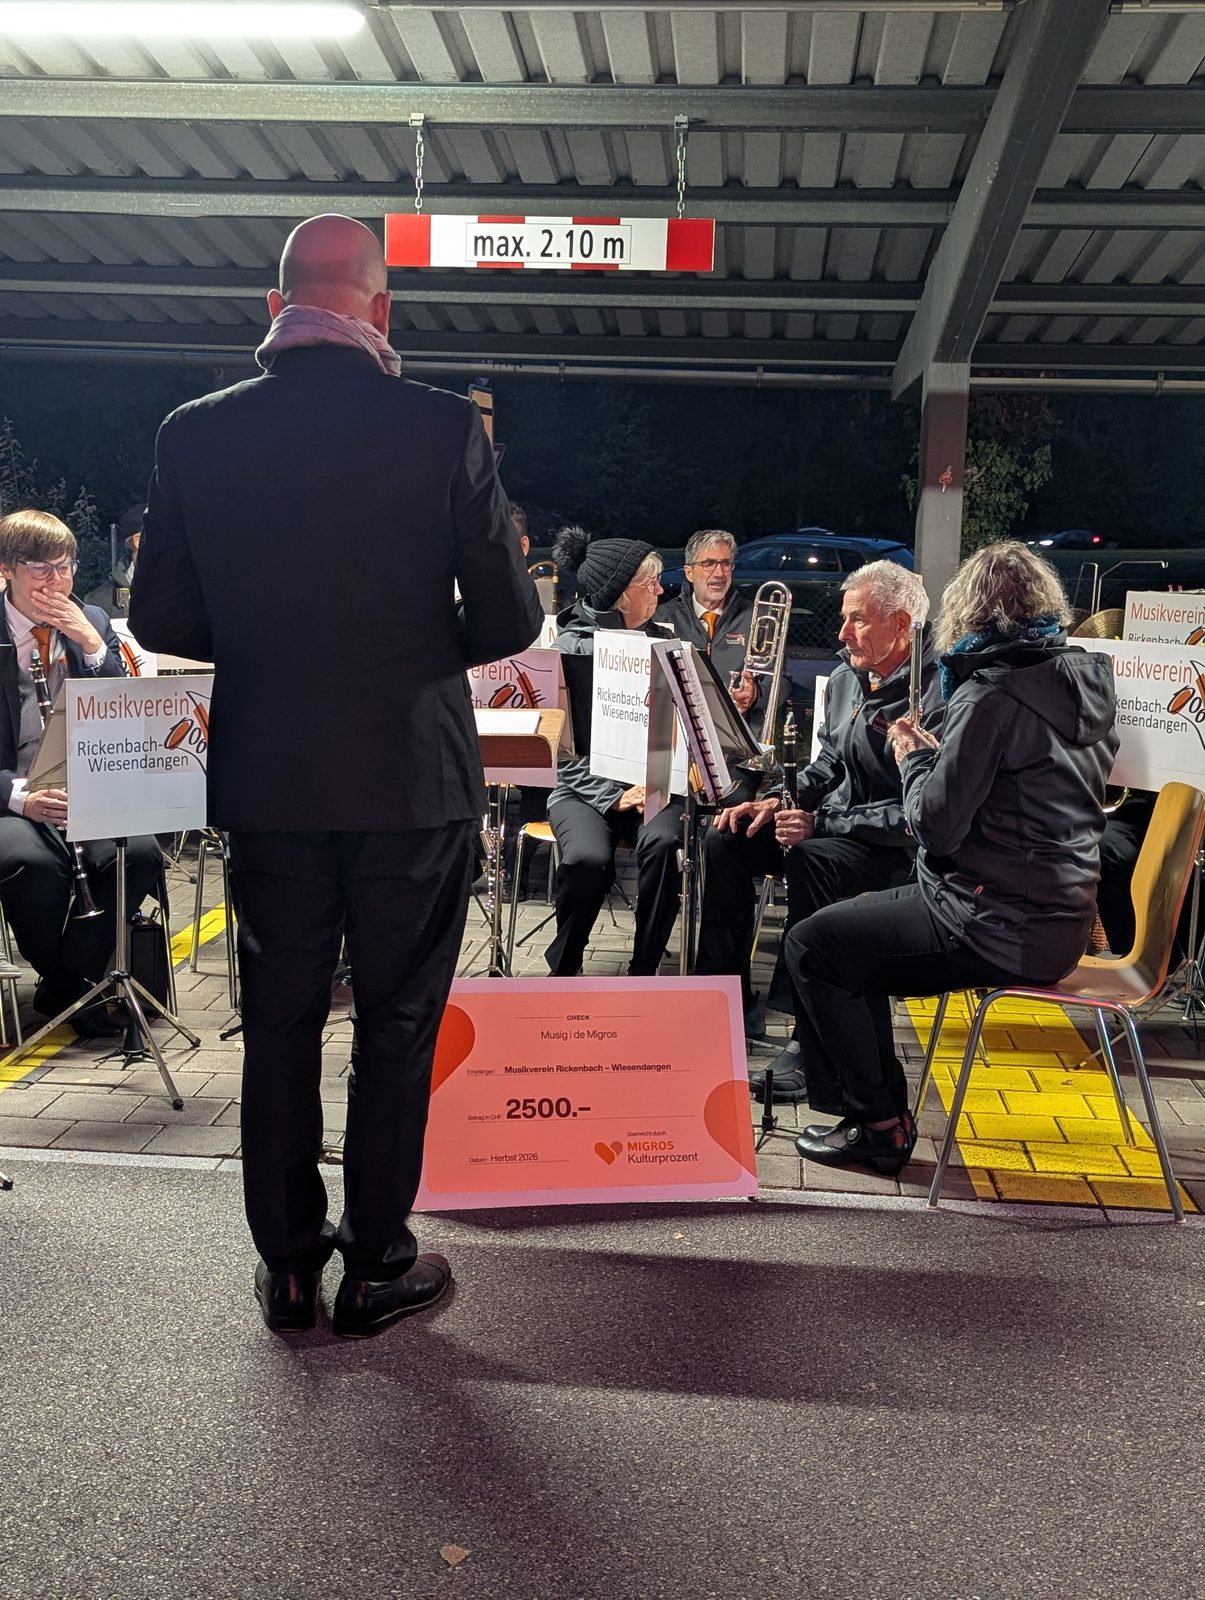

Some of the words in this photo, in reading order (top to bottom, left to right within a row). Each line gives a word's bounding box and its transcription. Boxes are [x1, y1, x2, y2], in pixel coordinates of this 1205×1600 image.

[473, 234, 531, 258] max.
[540, 229, 594, 259] 2.10
[603, 237, 624, 259] m
[1131, 602, 1205, 625] Musikverein
[598, 647, 650, 676] Musikvere
[76, 692, 190, 721] Musikverein
[597, 687, 645, 707] Rickenbach-
[1115, 694, 1167, 714] kenbach-
[602, 703, 649, 728] Wiesendang
[77, 736, 163, 757] Rickenbach-
[88, 754, 189, 773] Wiesendangen
[540, 1030, 568, 1042] Musig
[573, 1030, 586, 1040] de
[586, 1029, 618, 1041] Migros
[504, 1065, 555, 1074] Musikverein
[556, 1064, 603, 1073] Rickenbach
[611, 1063, 671, 1073] Wiesendangen
[627, 1140, 675, 1152] MIGROS
[490, 1153, 518, 1162] Herbst
[518, 1152, 539, 1162] 2026
[627, 1152, 699, 1165] Kulturprozent
